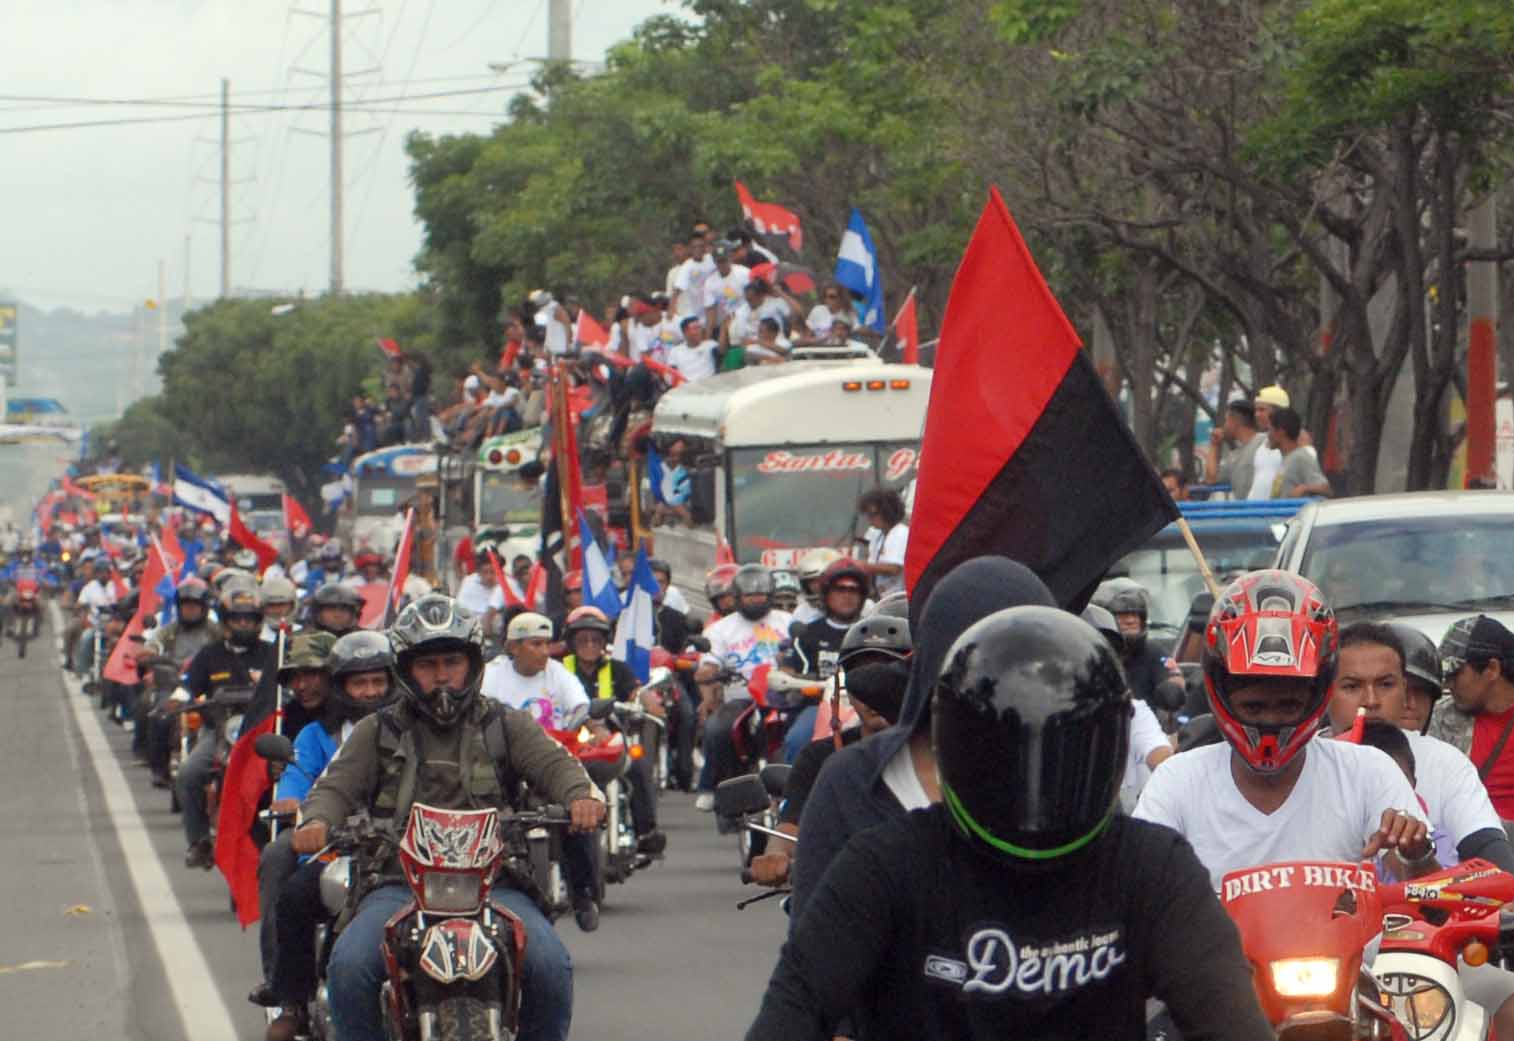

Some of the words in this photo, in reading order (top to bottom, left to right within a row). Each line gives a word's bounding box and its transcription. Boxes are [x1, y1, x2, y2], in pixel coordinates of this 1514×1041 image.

[757, 450, 872, 473] Santa
[1225, 866, 1295, 902] DIRT
[1303, 865, 1376, 892] BIKE
[963, 929, 1125, 992] Demo
